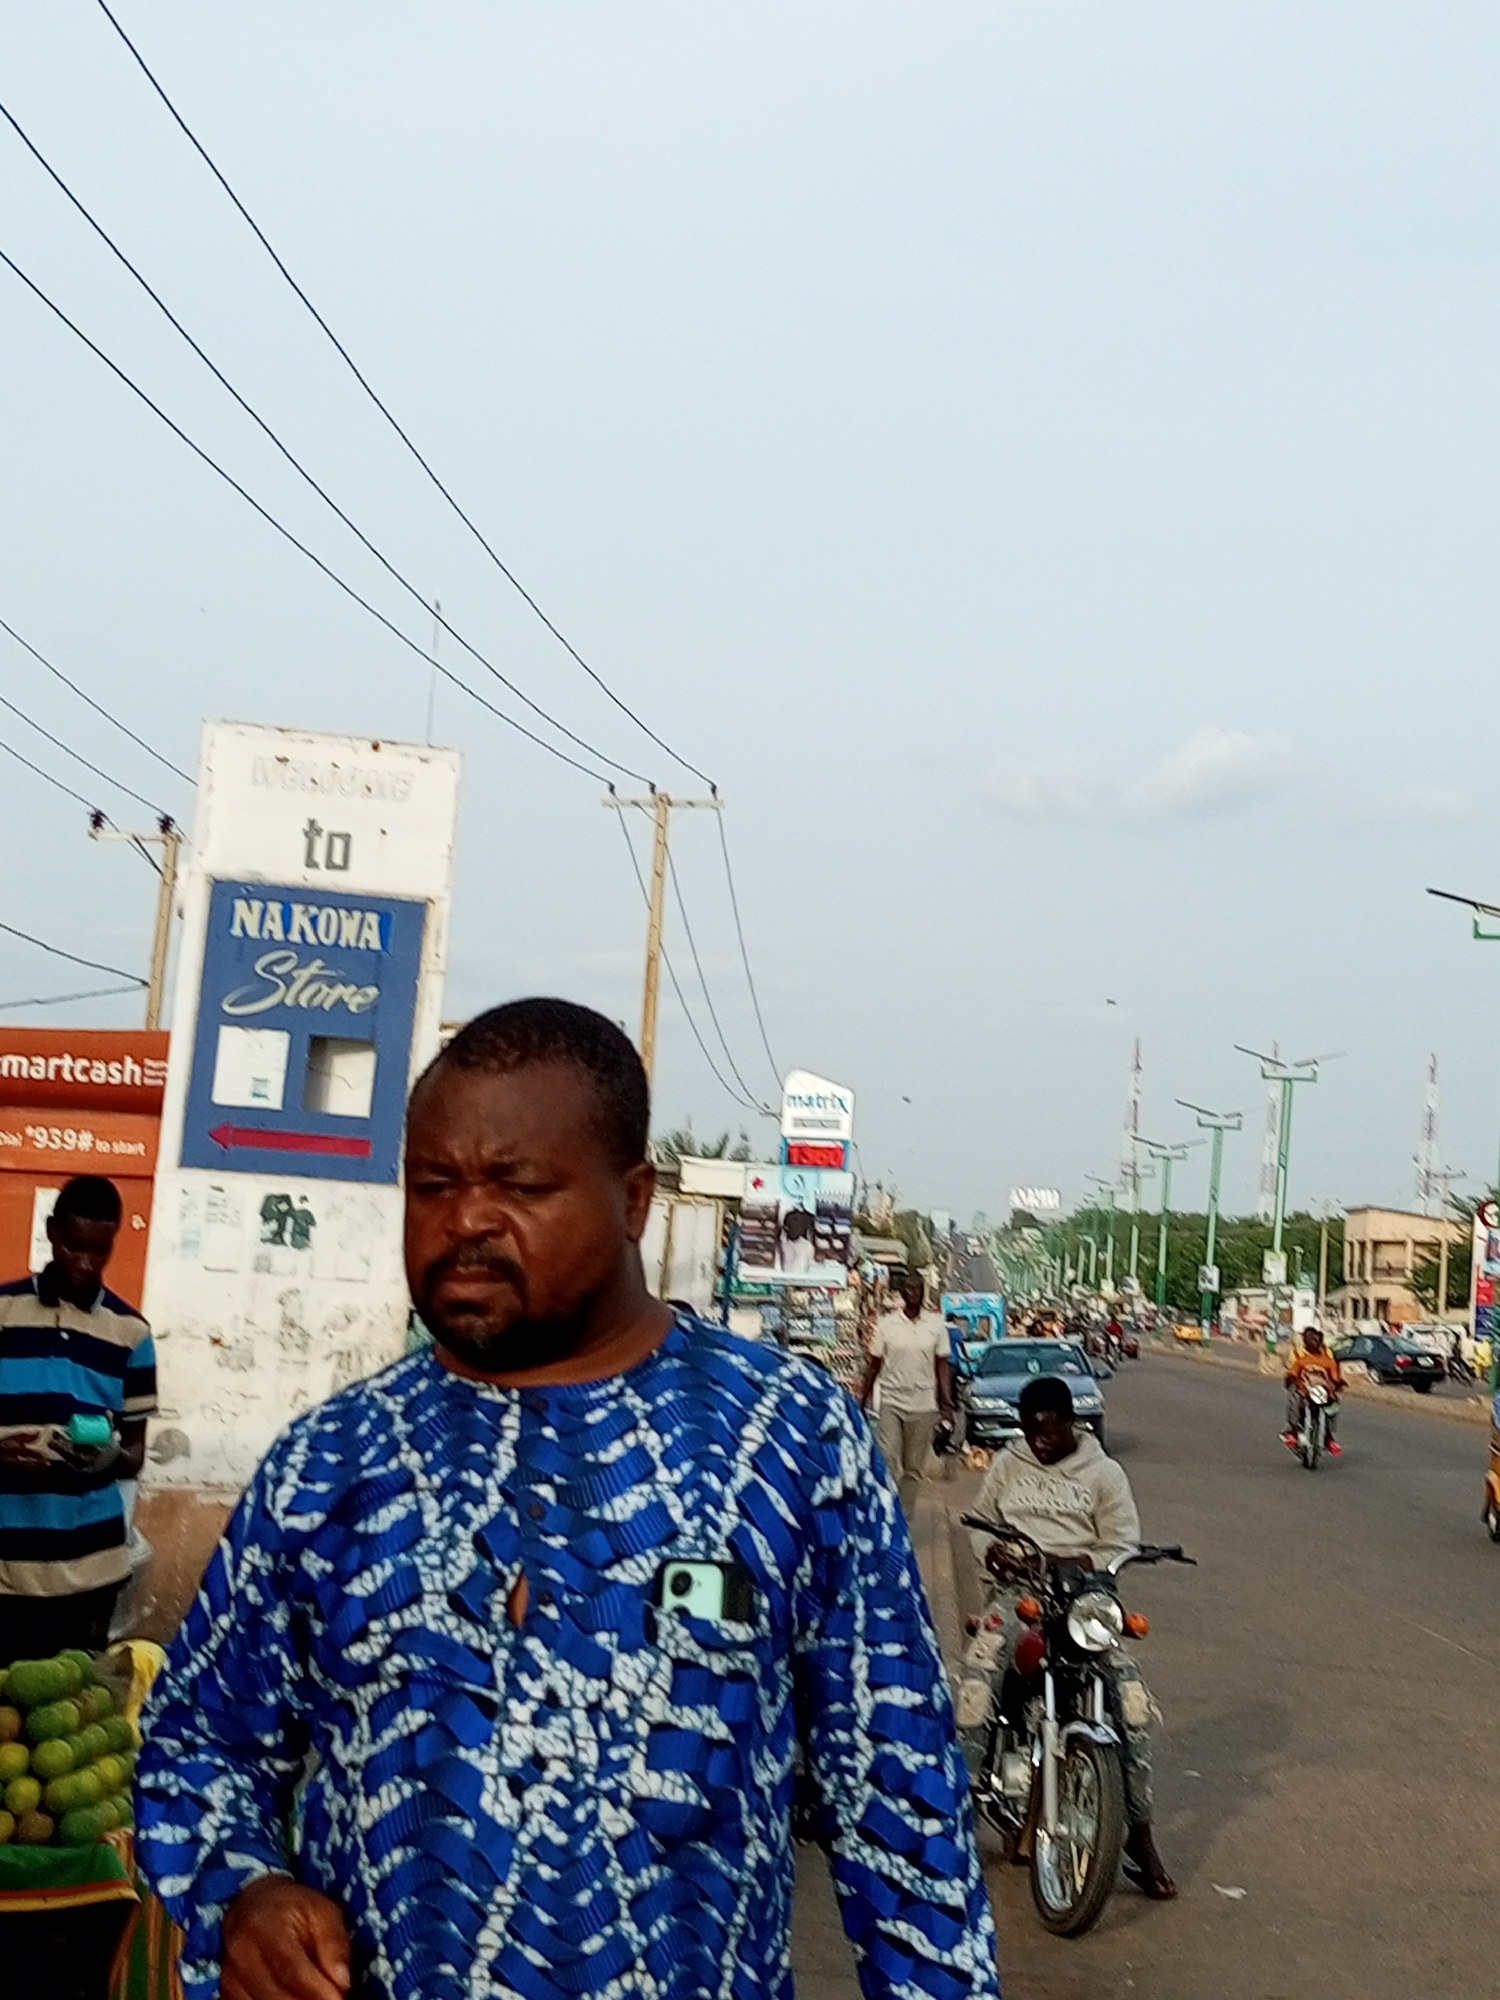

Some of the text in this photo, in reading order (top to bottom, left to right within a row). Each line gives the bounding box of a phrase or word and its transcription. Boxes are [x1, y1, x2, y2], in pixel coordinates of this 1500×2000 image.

[303, 818, 352, 871] to
[230, 898, 383, 951] NAKOWA
[221, 949, 381, 1016] Store
[0, 1053, 142, 1087] martcash
